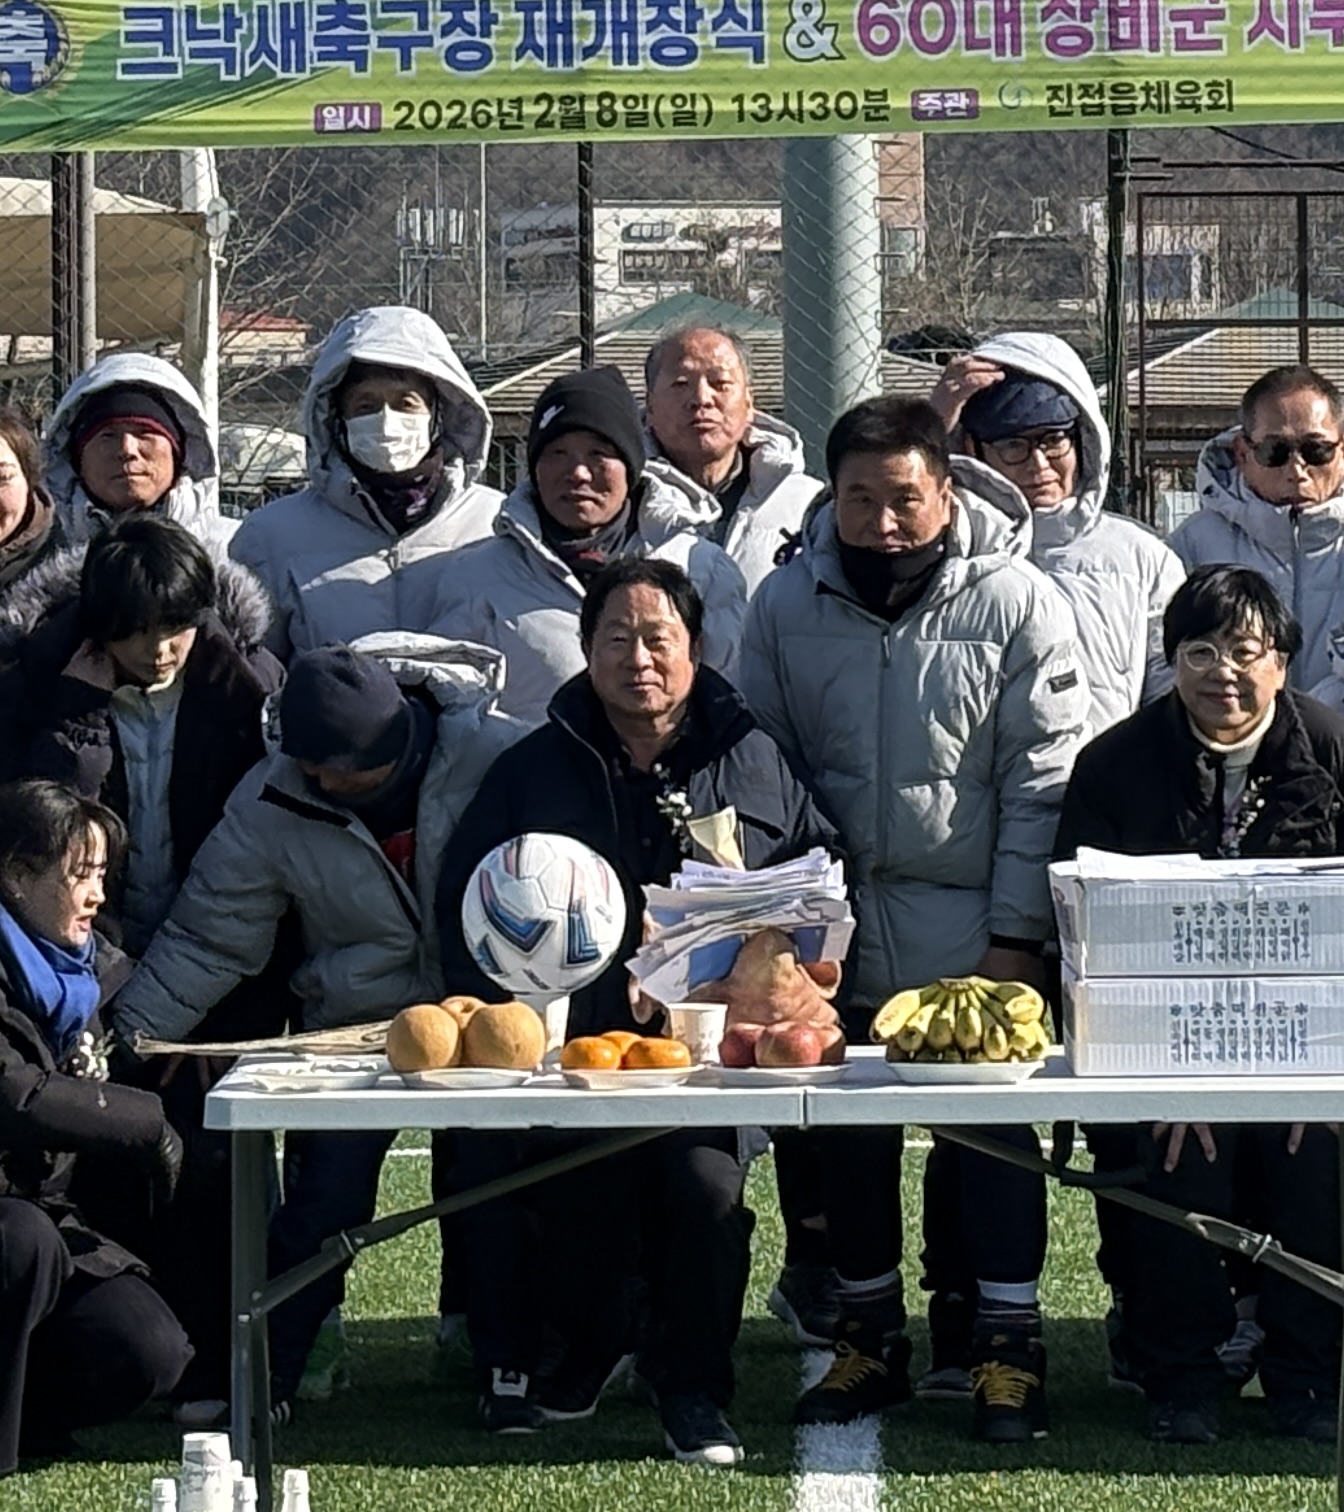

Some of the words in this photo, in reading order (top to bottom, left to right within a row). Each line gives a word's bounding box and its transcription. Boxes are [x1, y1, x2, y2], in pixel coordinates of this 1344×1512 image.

[322, 105, 371, 131] 일시
[731, 88, 891, 123] 13시30분
[918, 91, 970, 118] 주관
